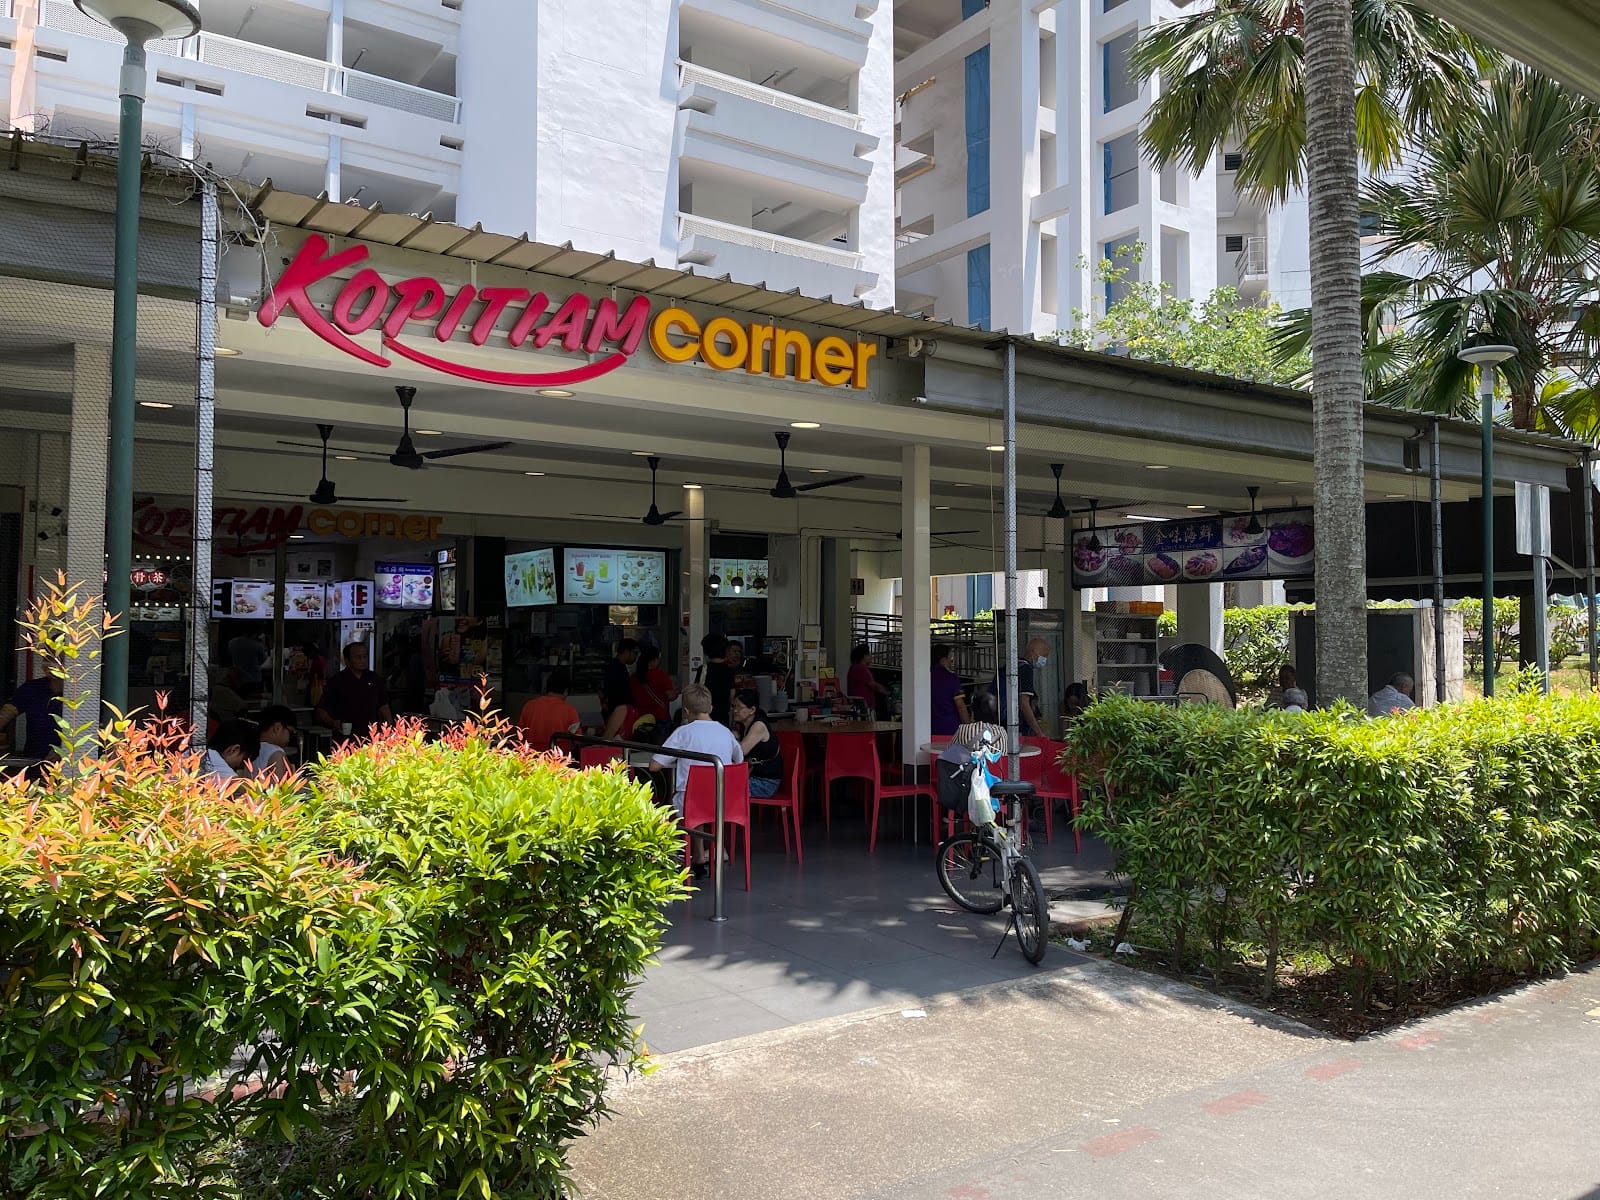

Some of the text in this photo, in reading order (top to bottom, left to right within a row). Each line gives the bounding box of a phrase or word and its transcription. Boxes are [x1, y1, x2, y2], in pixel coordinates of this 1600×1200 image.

[257, 233, 877, 389] KOPITIAM corner
[133, 498, 442, 553] OPTIAM corner
